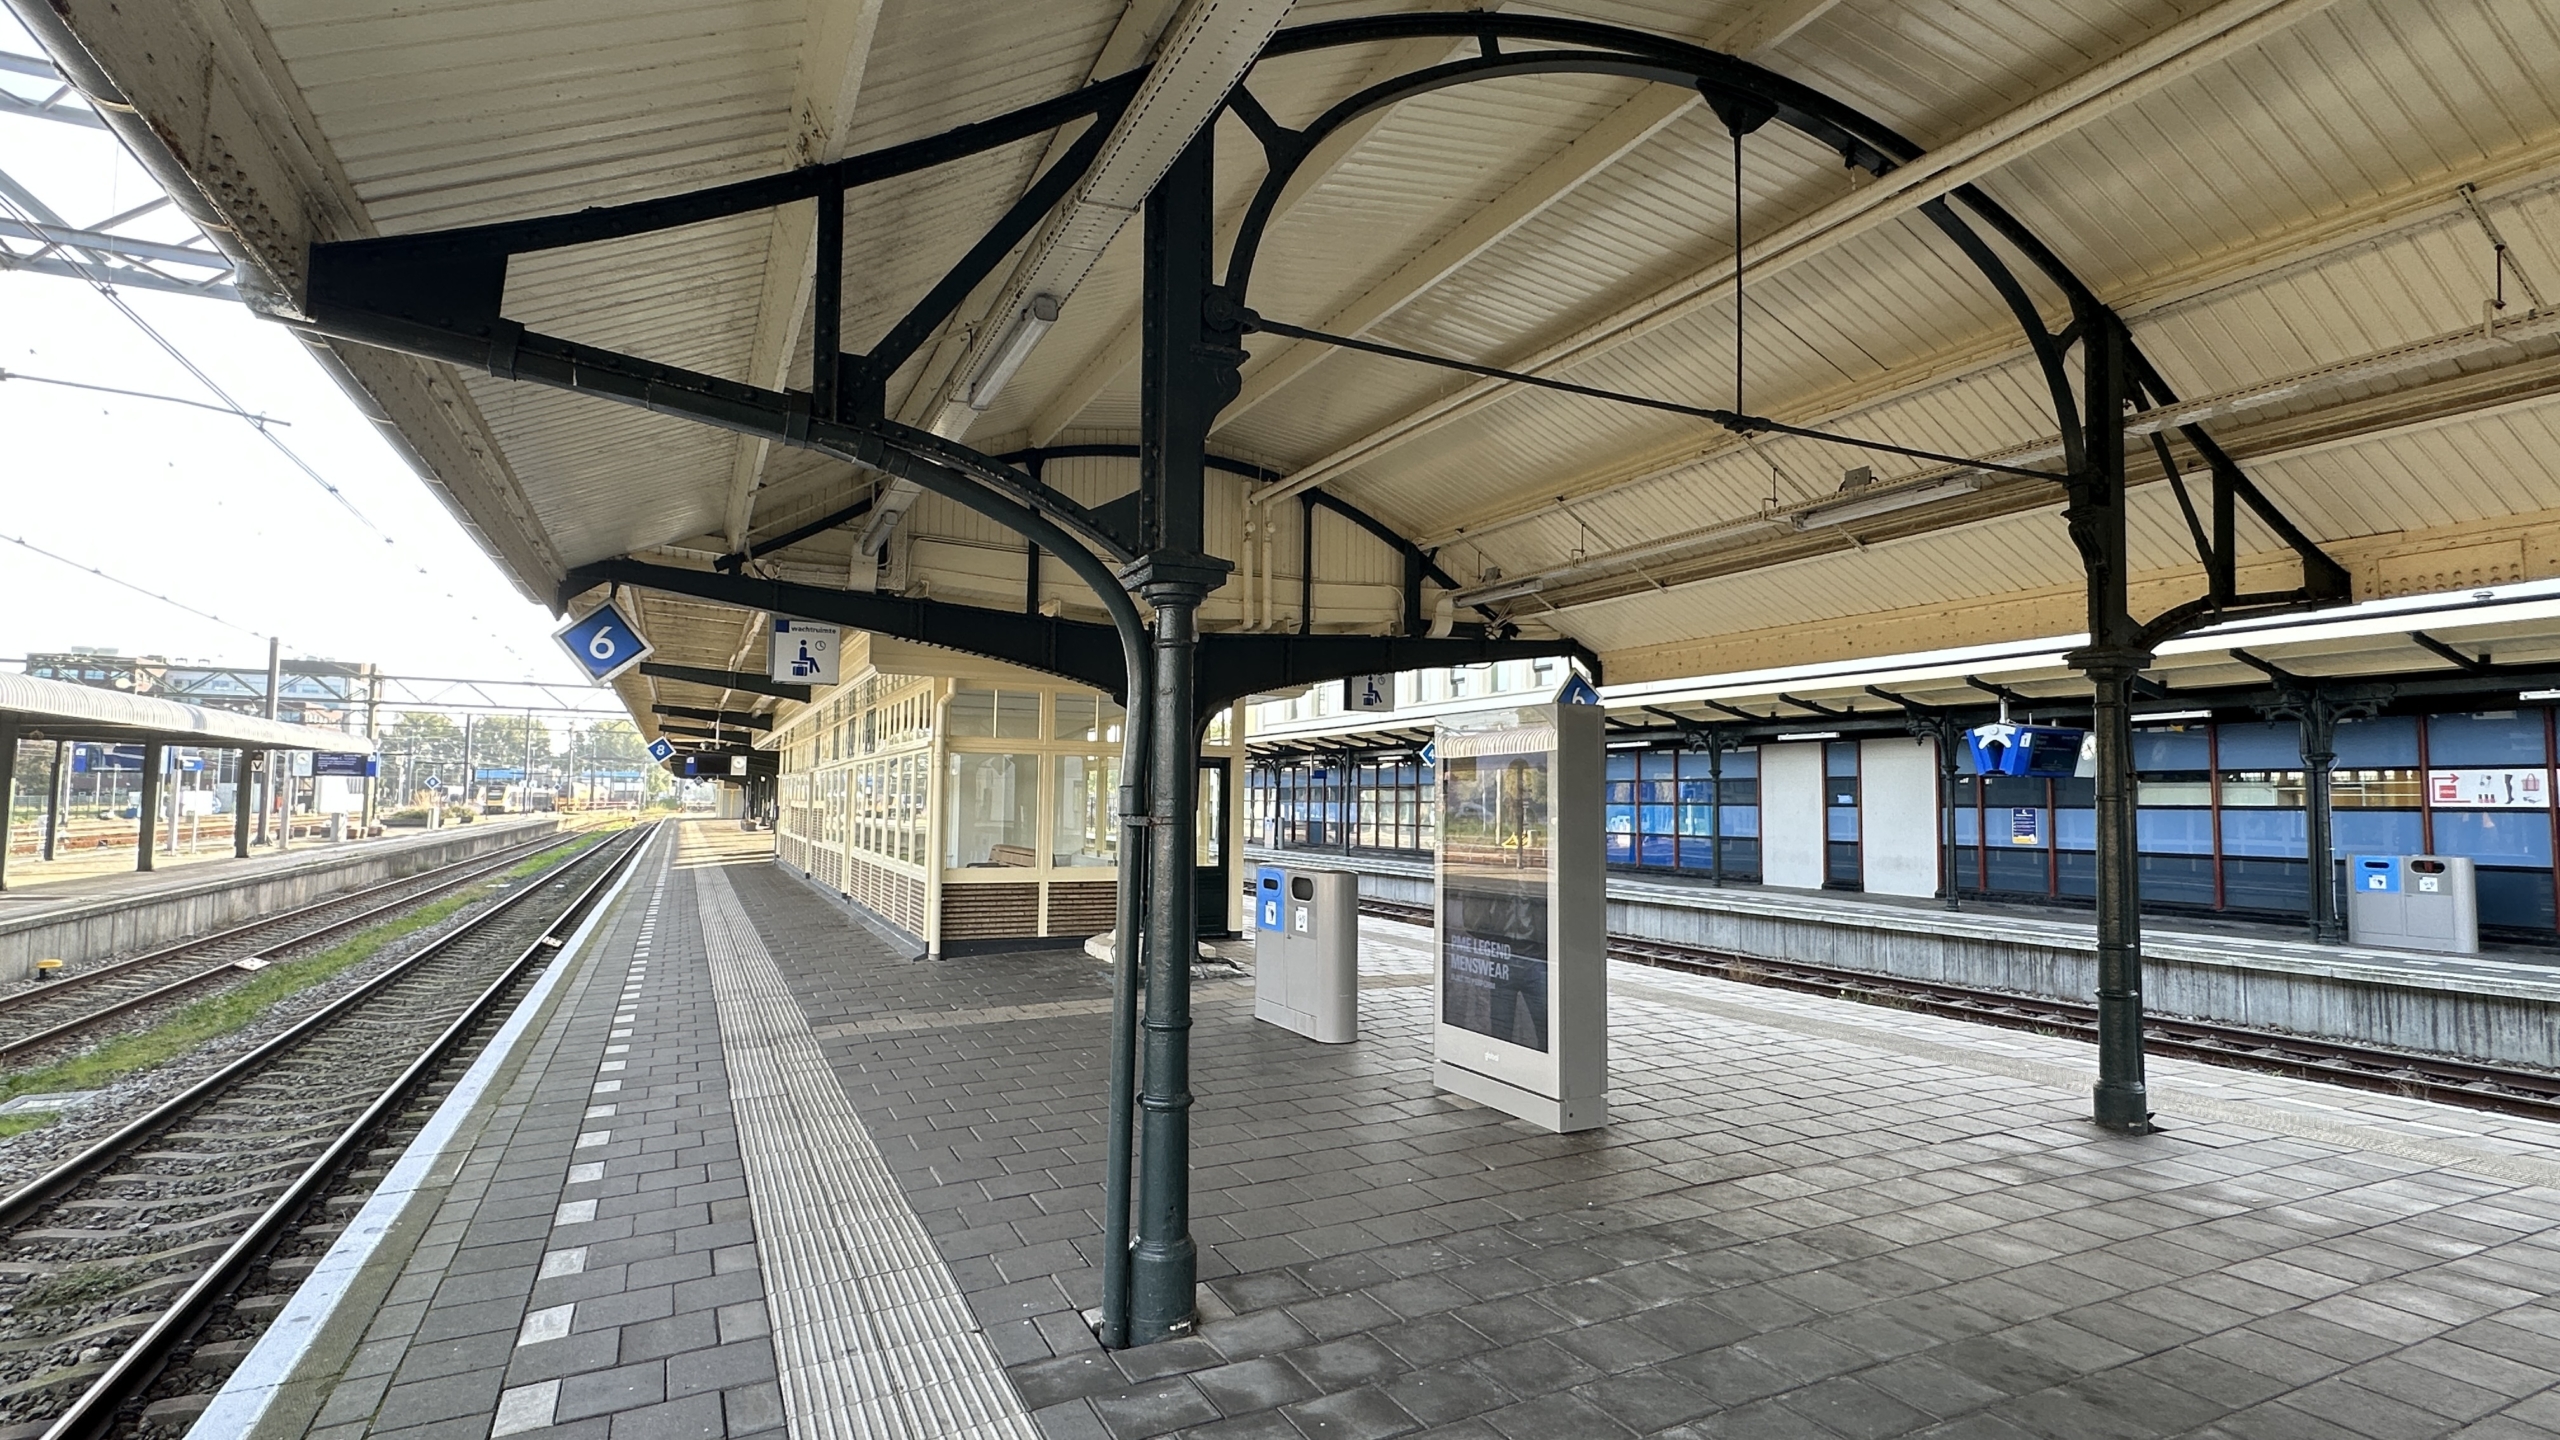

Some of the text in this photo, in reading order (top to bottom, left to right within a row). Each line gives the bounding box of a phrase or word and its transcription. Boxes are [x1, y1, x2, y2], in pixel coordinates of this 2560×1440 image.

[791, 626, 837, 634] wachtruimte
[589, 625, 615, 660] 6
[1572, 687, 1586, 705] 6
[656, 744, 666, 756] 8
[252, 761, 262, 770] V
[1451, 934, 1511, 960] PME LEGEND
[1450, 953, 1509, 980] MENSWEAR
